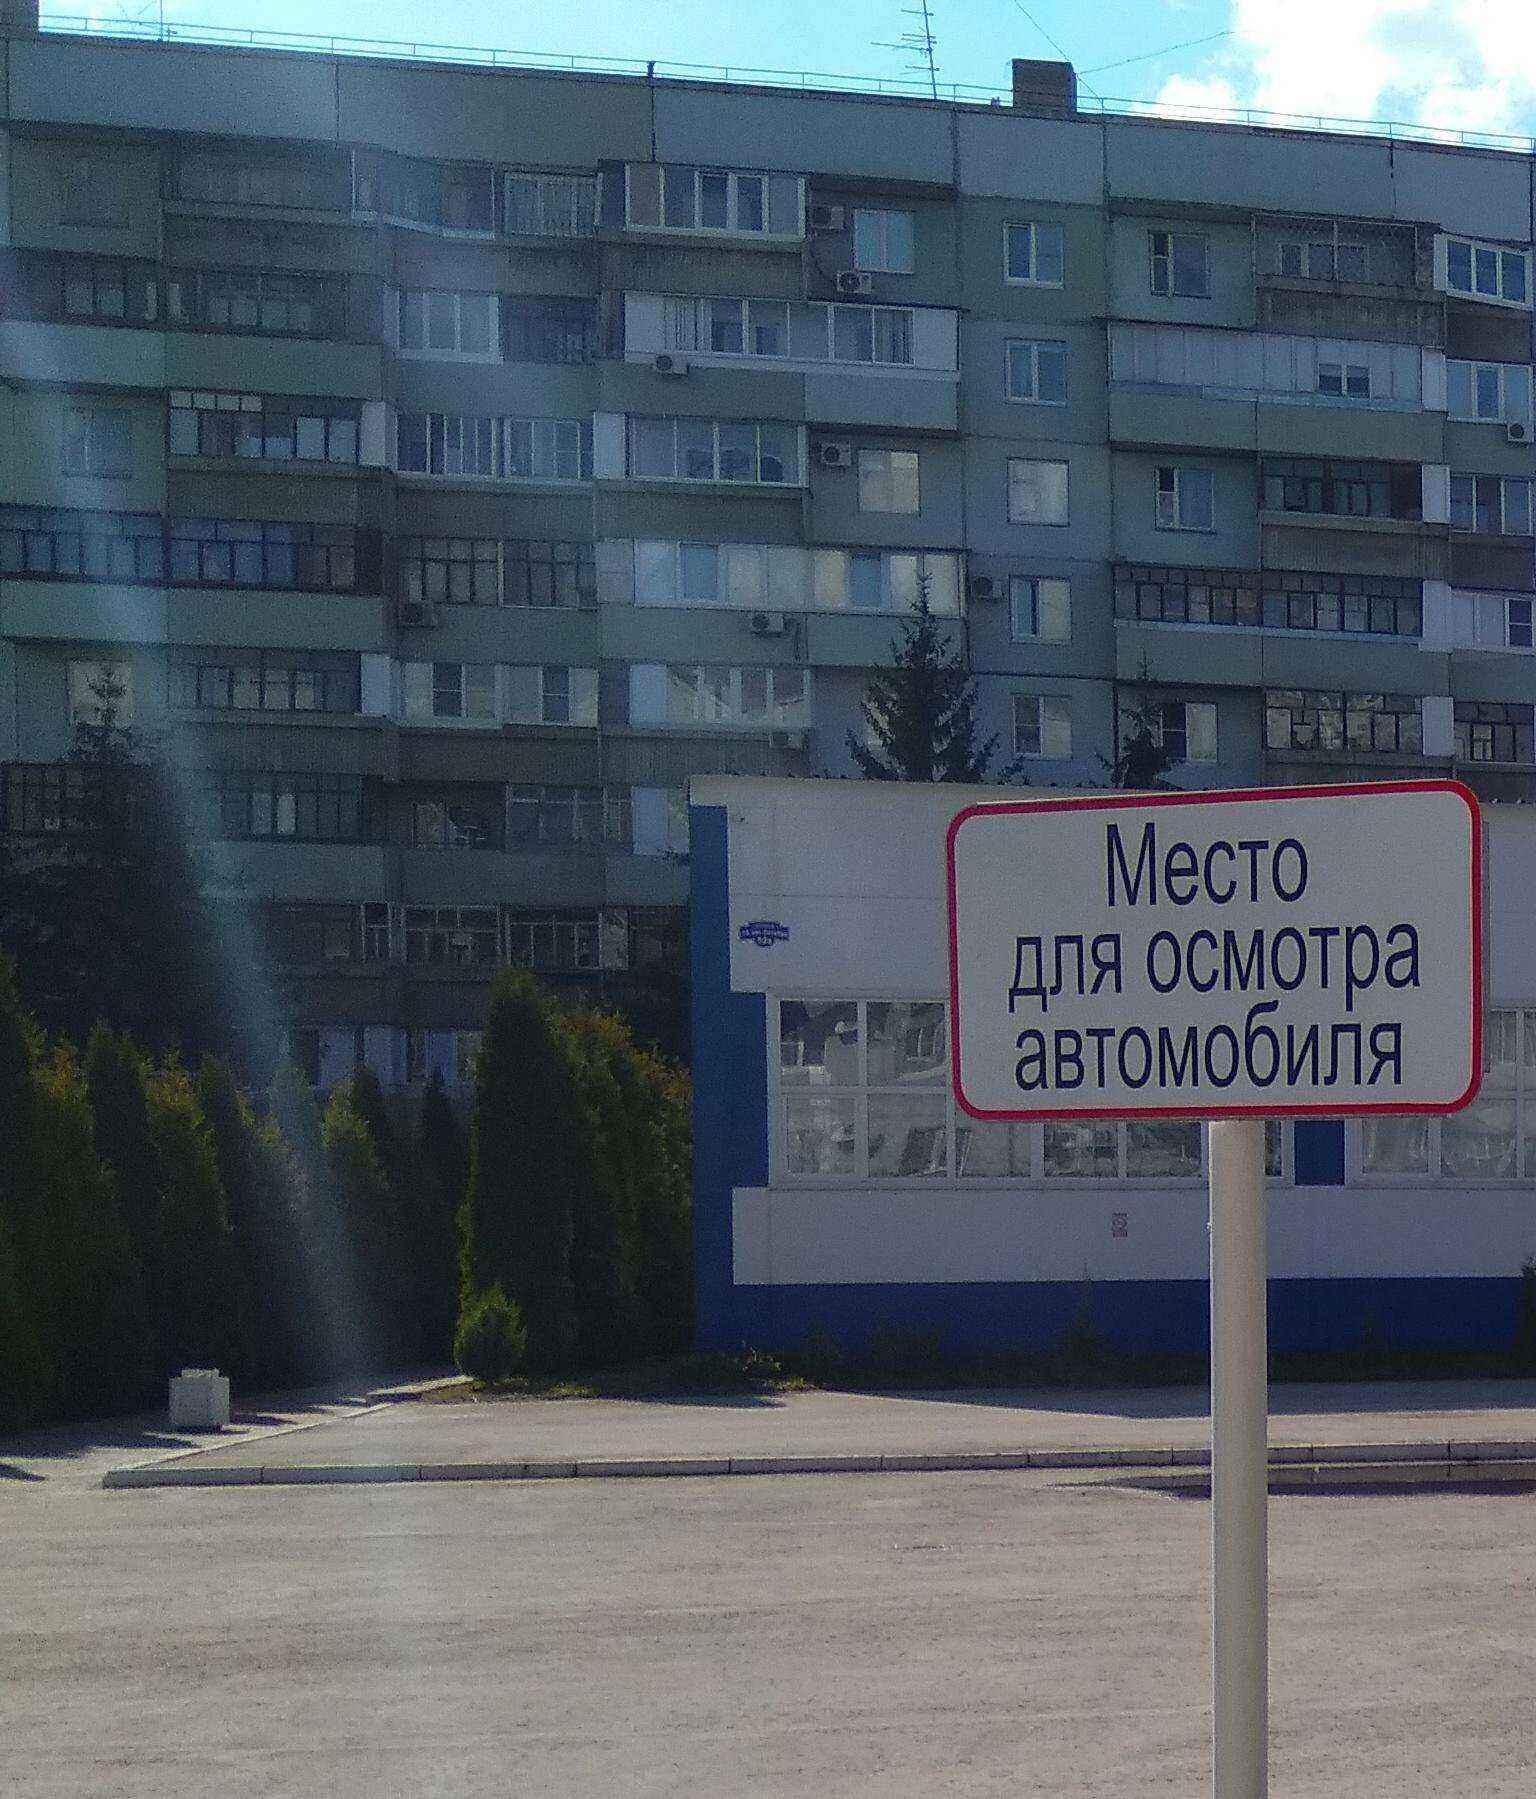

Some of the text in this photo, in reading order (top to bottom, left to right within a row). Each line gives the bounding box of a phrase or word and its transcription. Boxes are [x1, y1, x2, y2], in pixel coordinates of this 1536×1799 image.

[1106, 821, 1308, 907] Место
[1008, 919, 1421, 1013] для осмотра
[1014, 999, 1402, 1091] автомобиля
